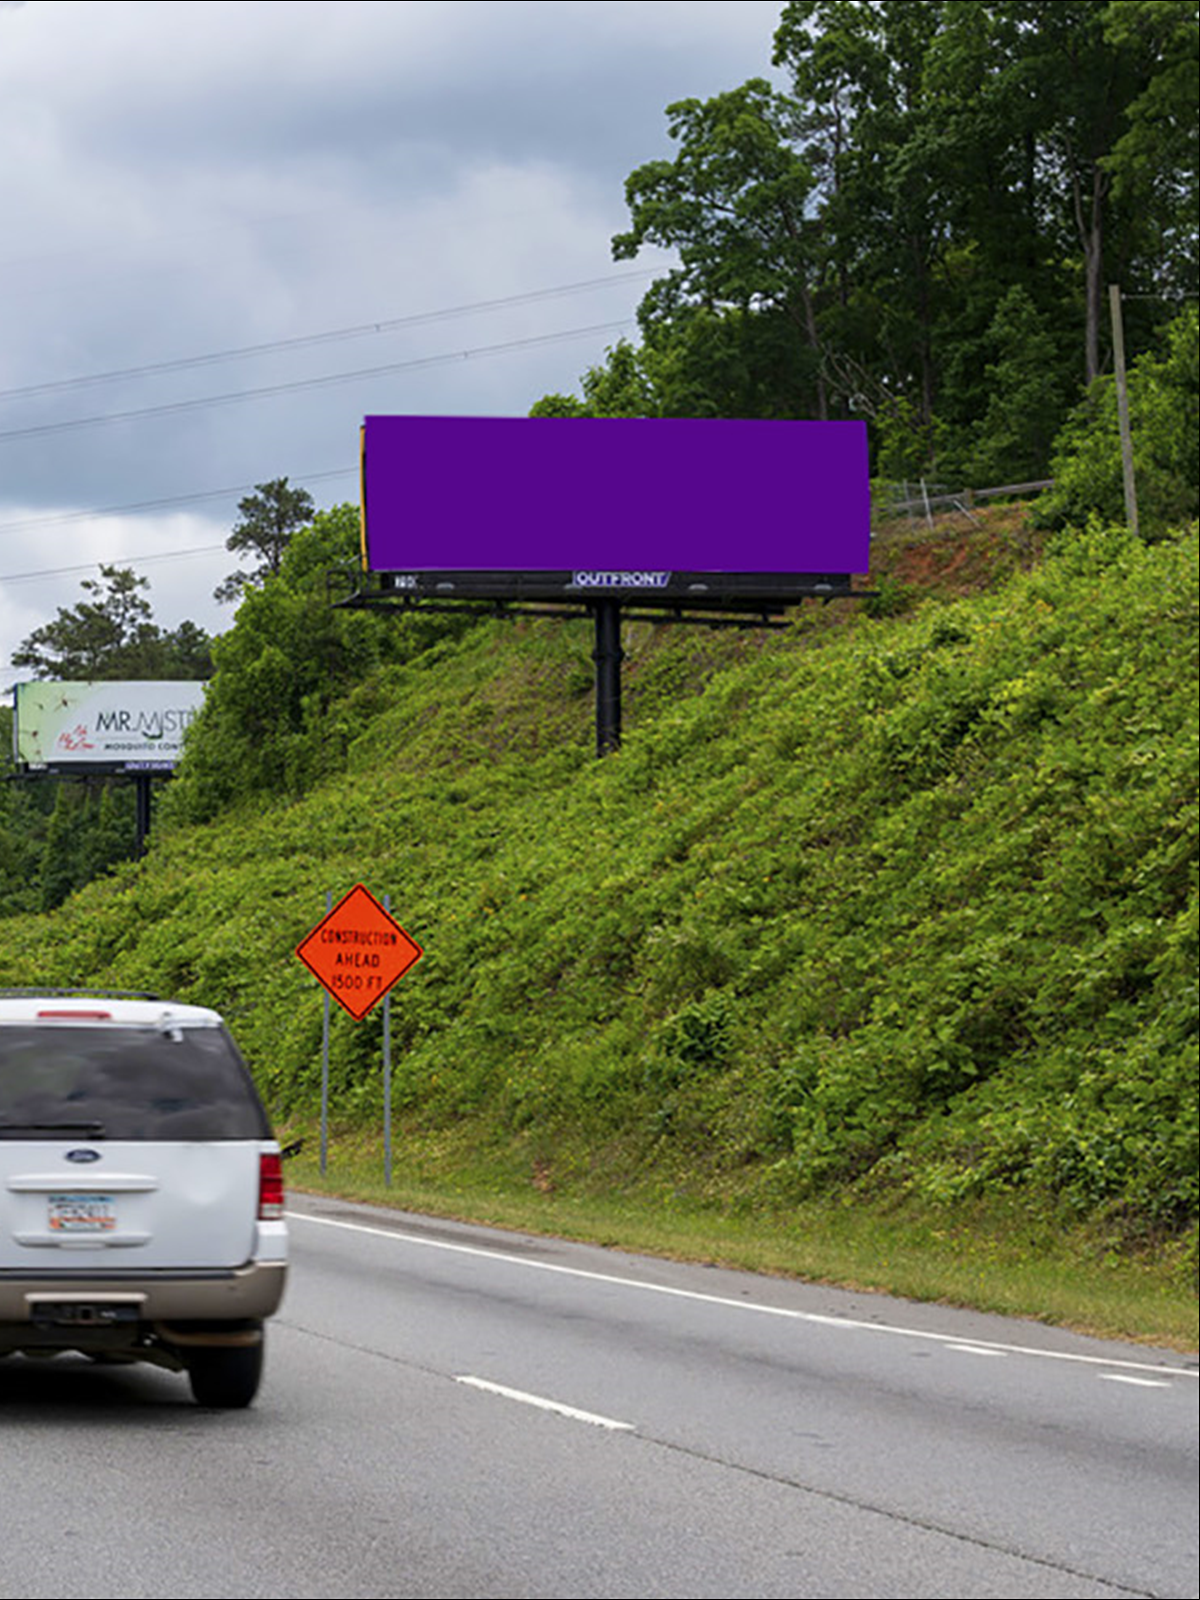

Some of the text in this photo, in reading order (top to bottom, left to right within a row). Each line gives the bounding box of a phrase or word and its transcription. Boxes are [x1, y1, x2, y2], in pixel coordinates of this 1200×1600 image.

[576, 572, 668, 587] OUTFRONT
[104, 742, 156, 751] MOSQUITO
[321, 929, 397, 946] CONSTRUCTION
[336, 953, 380, 968] AHEAD
[332, 974, 382, 990] 1500 FT
